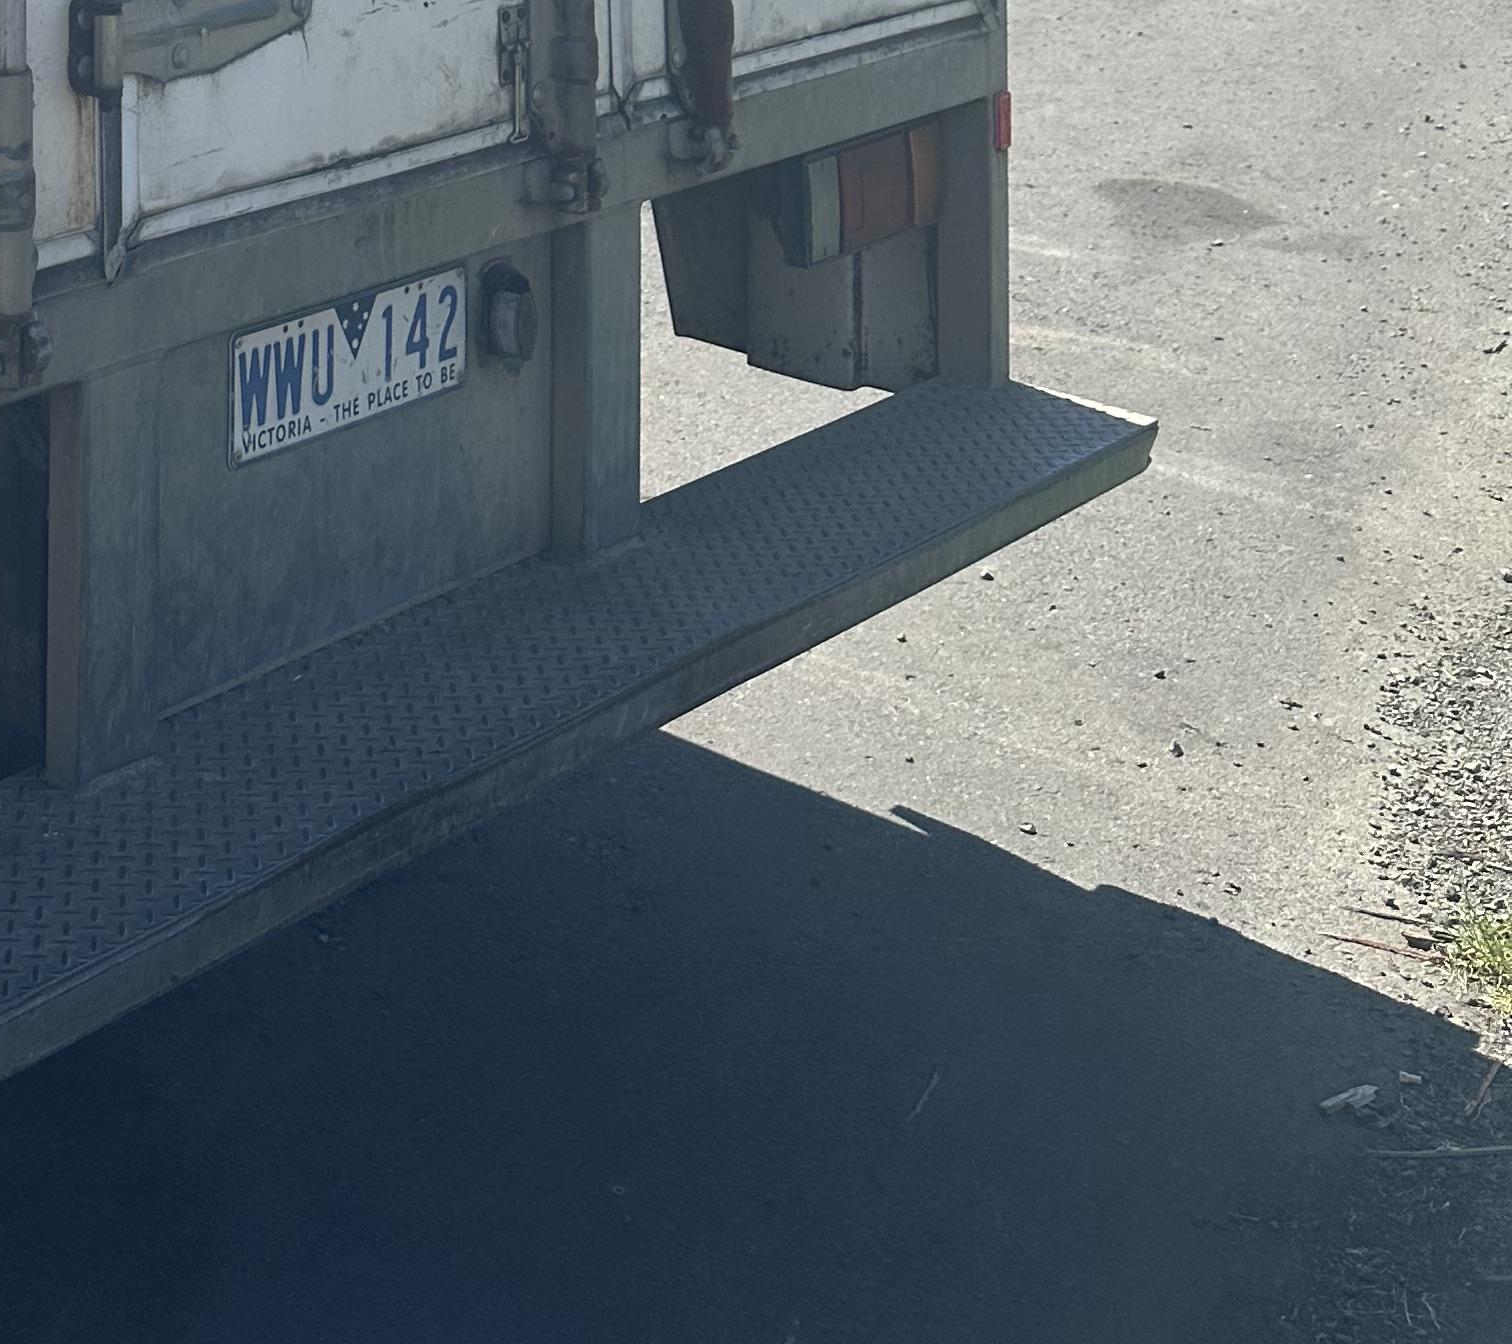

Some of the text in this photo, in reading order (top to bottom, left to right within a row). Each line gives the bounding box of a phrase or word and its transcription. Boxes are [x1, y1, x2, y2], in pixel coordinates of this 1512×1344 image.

[238, 284, 458, 430] WWU 142
[241, 414, 313, 454] VICTORIA
[333, 397, 360, 423] THE
[367, 379, 409, 411] PLACE
[415, 371, 433, 392] TO
[440, 363, 456, 384] BE
